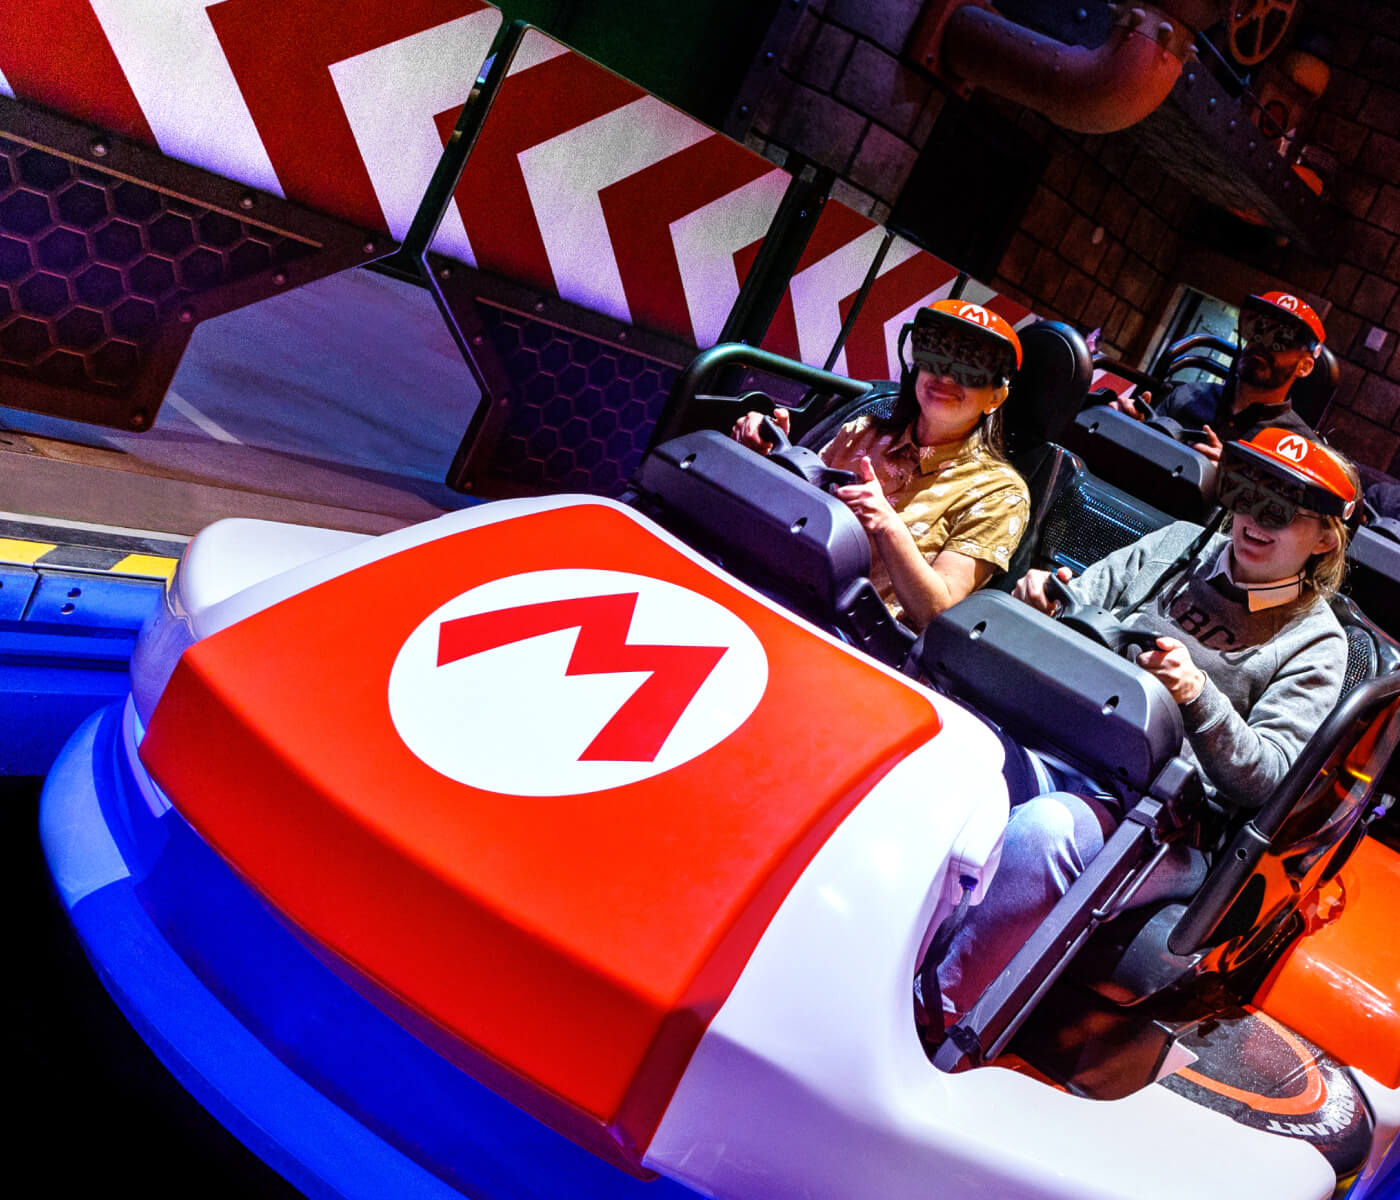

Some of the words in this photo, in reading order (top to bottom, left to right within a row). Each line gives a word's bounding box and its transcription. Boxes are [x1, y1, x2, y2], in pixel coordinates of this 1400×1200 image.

[960, 306, 985, 327] M
[1278, 438, 1304, 460] M
[436, 591, 730, 762] M
